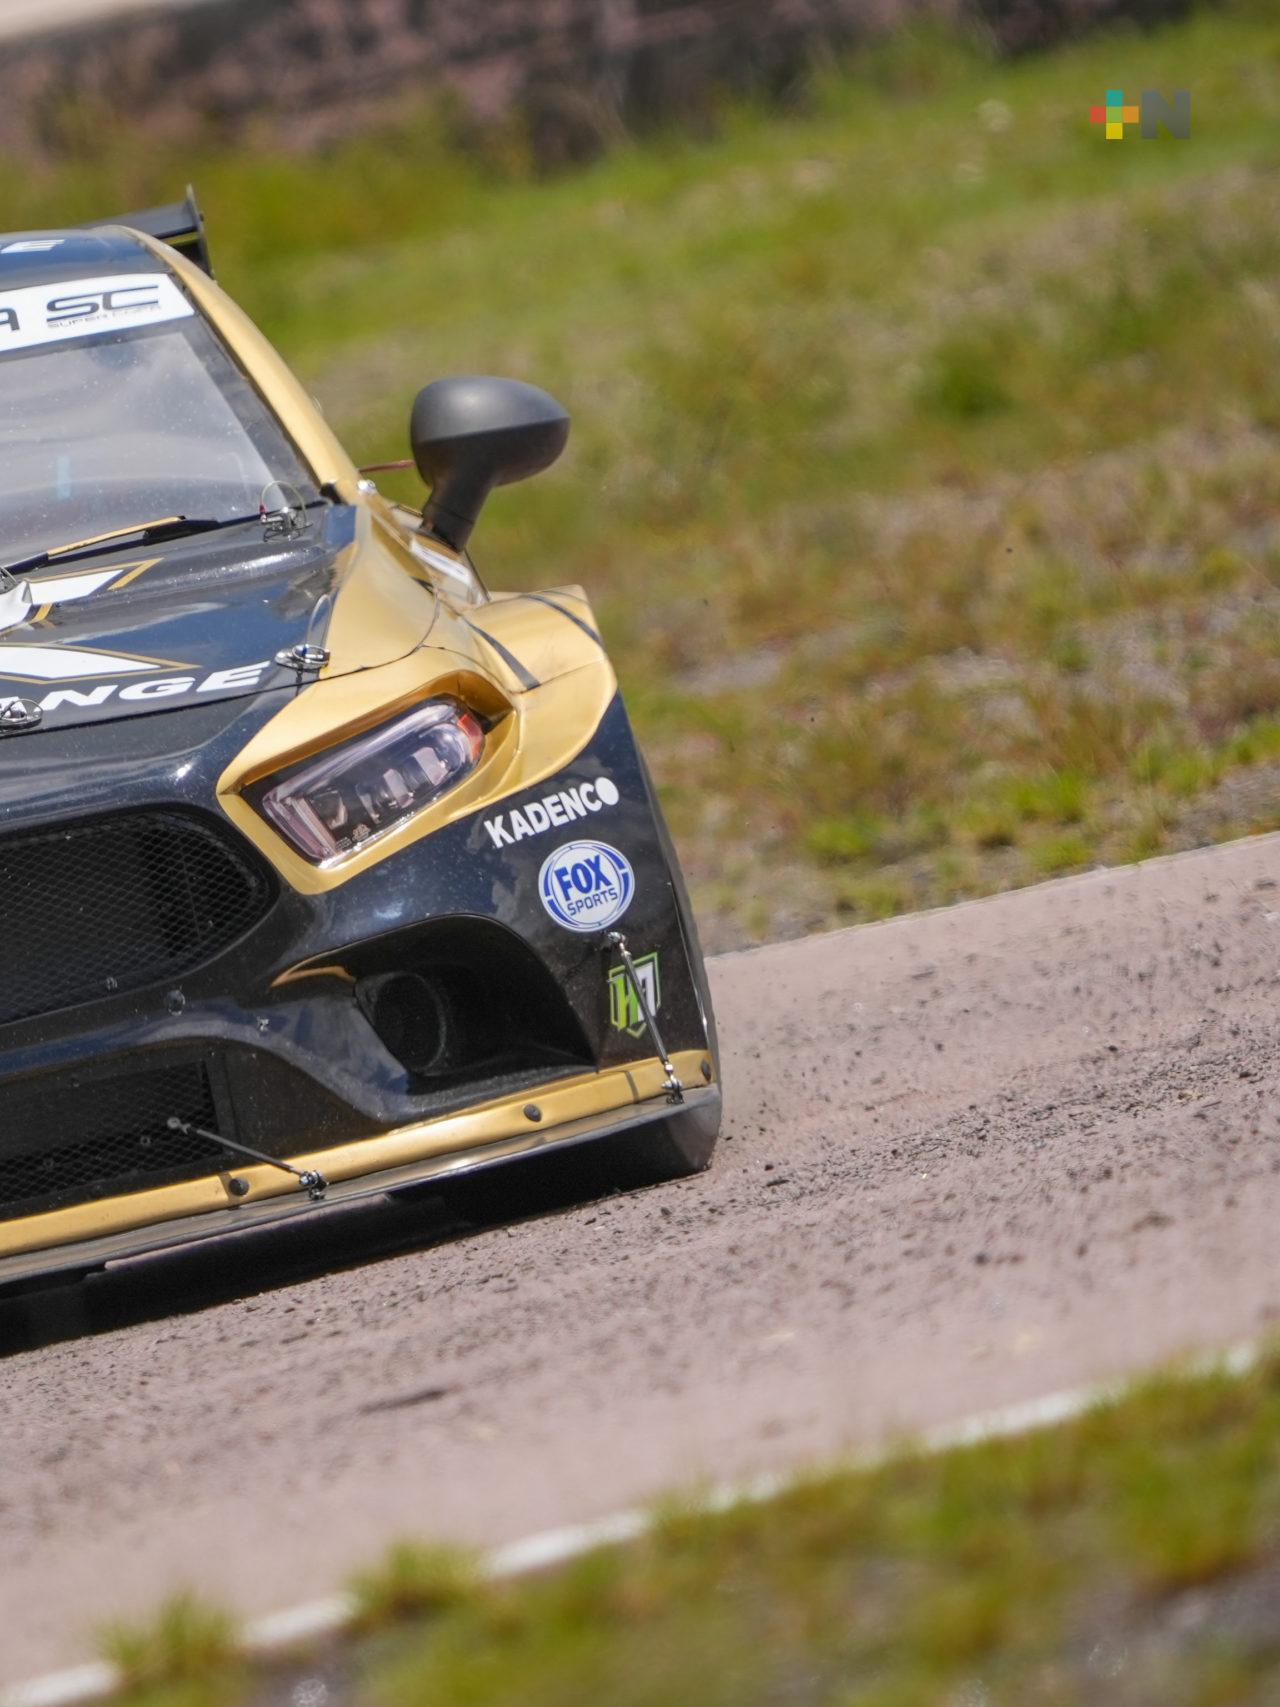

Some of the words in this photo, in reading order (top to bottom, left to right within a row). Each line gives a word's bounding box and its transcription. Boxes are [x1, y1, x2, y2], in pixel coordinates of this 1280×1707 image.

[46, 284, 159, 322] SC
[553, 854, 613, 902] FOX
[566, 886, 619, 917] SPORTS
